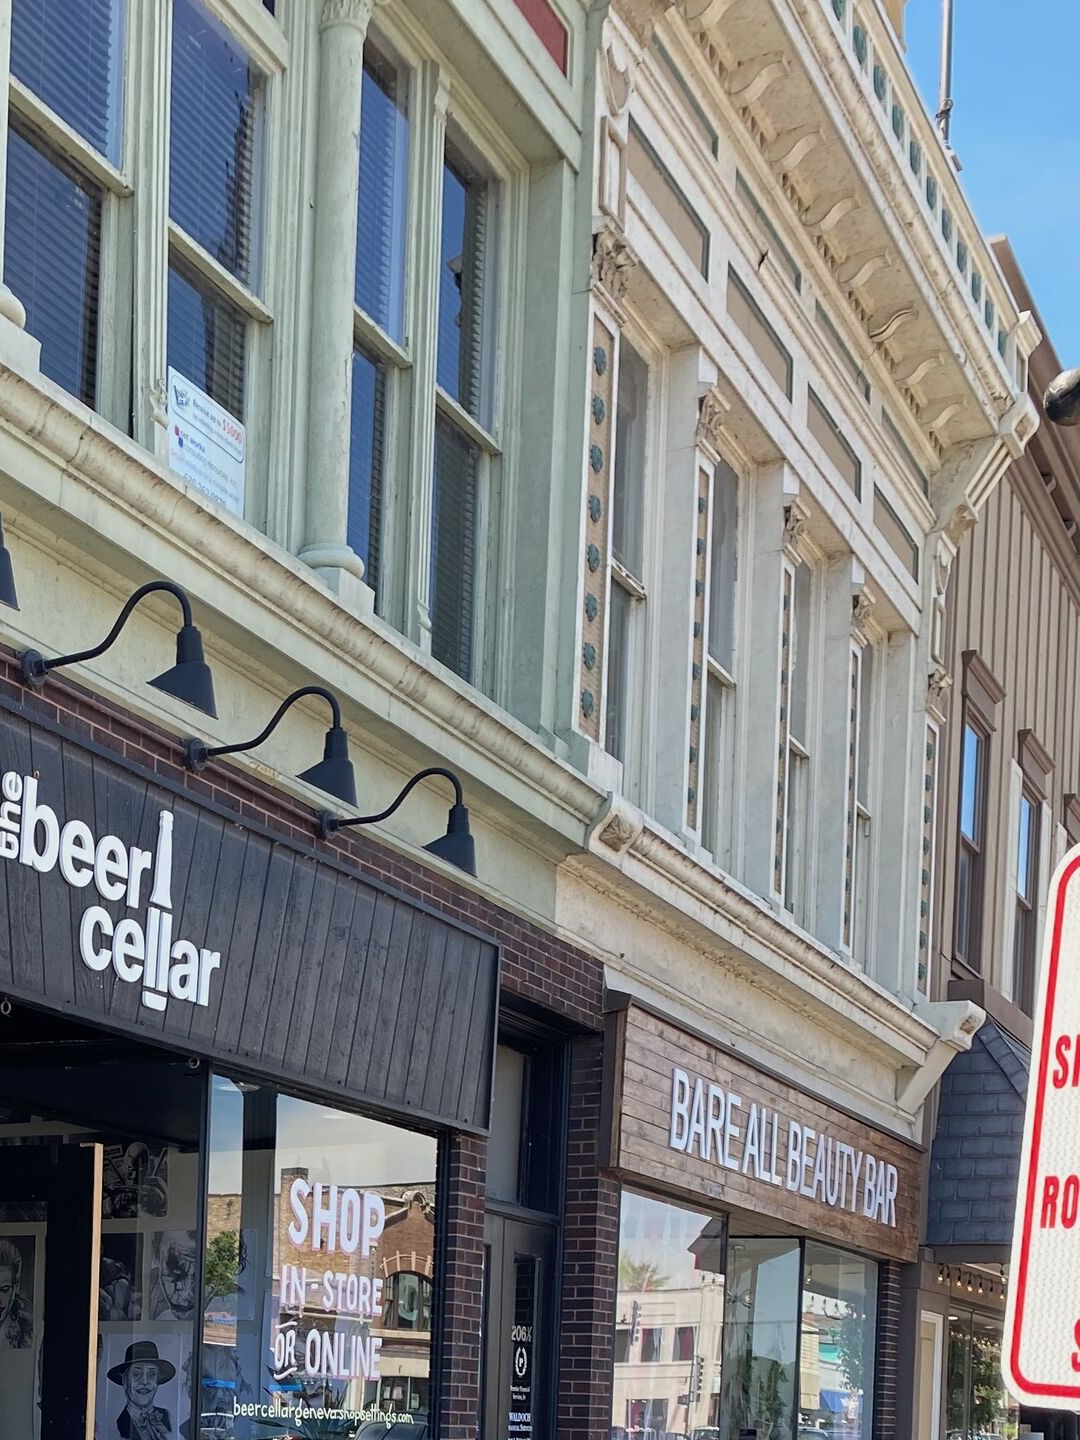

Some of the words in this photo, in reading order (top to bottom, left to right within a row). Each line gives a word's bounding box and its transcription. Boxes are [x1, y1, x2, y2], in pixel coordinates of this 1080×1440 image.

[19, 775, 152, 909] beer
[80, 905, 220, 1011] cellar
[670, 1067, 742, 1171] BARE
[742, 1103, 783, 1186] ALL
[786, 1120, 863, 1212] BEAUTY
[863, 1153, 899, 1227] BAR
[287, 1178, 385, 1259] SHOP
[274, 1329, 298, 1371] OR
[305, 1329, 383, 1380] ONLINE
